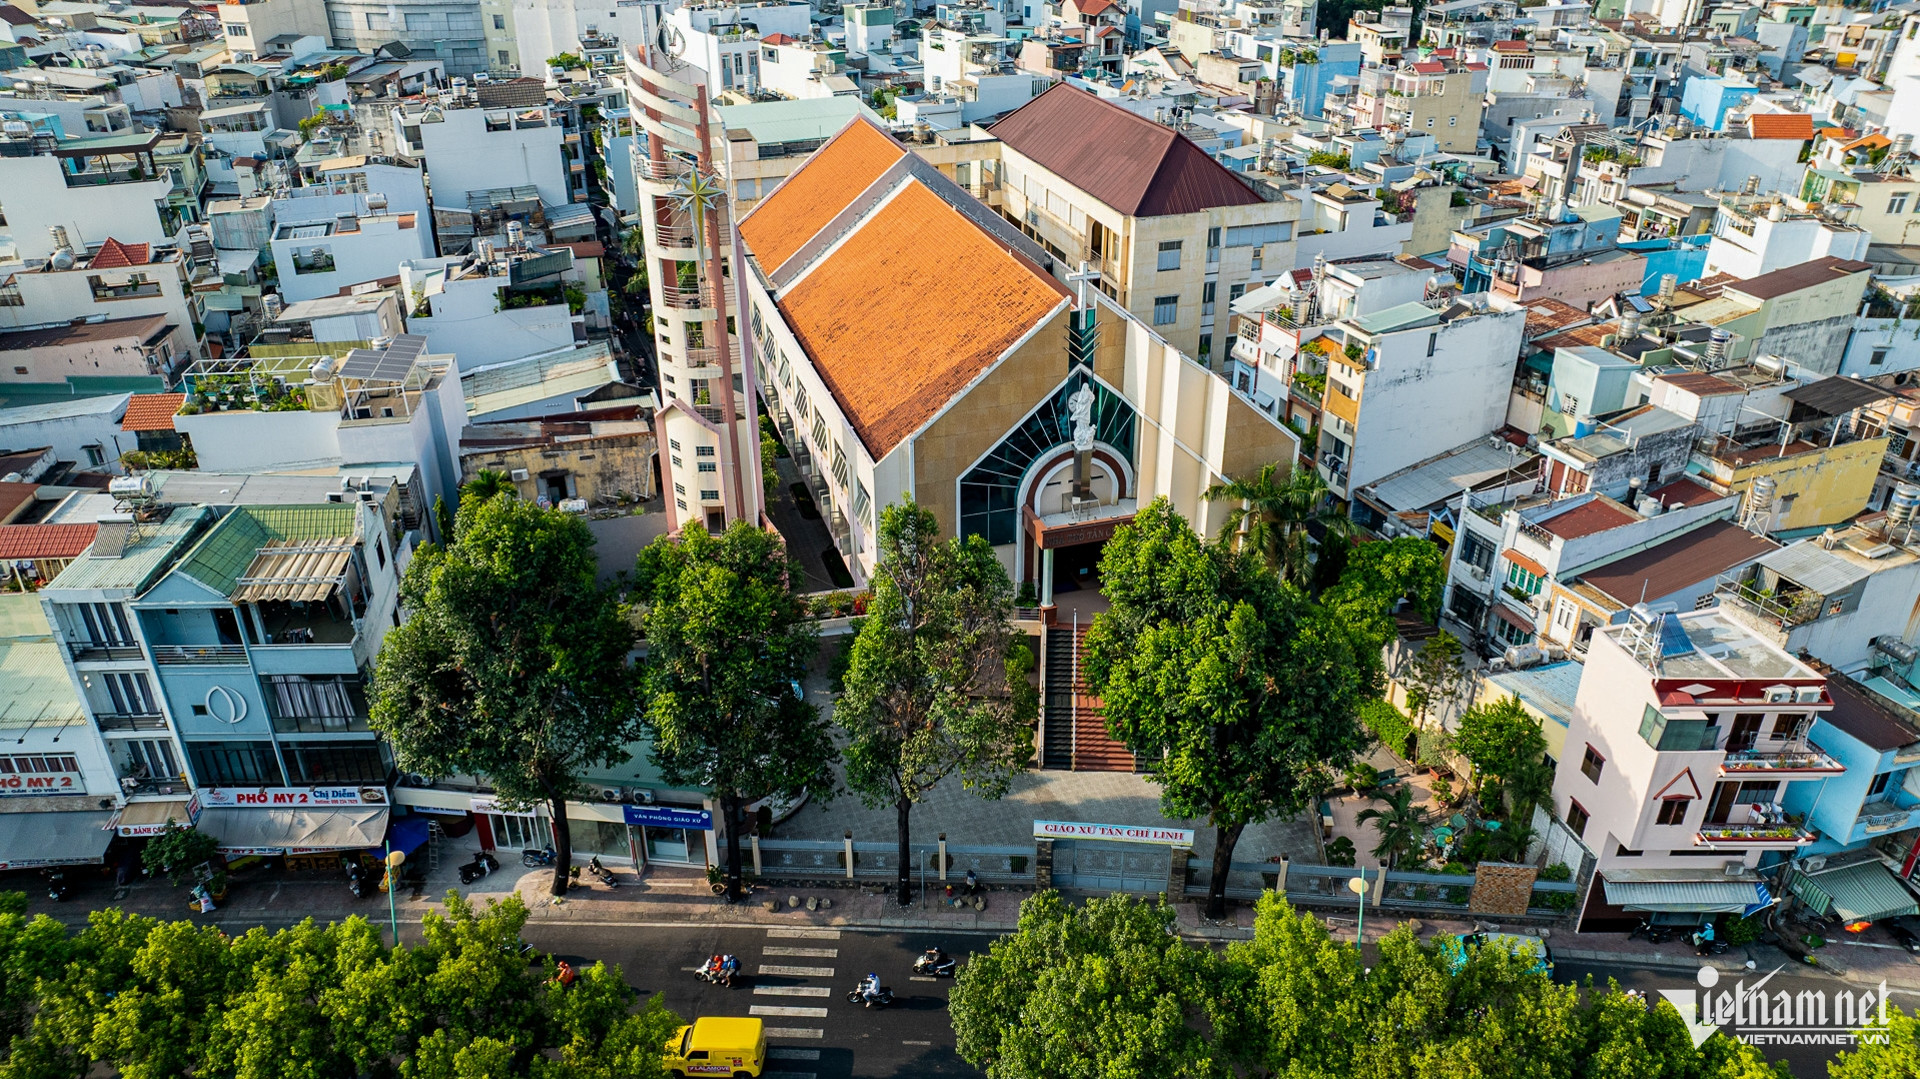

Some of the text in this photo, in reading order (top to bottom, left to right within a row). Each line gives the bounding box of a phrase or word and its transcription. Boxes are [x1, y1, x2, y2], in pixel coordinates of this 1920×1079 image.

[27, 777, 55, 788] MY
[60, 777, 72, 787] 2
[273, 793, 295, 804] MY
[298, 793, 308, 804] 2
[1044, 823, 1075, 833] GIÁO
[1099, 825, 1123, 836] TÂN
[1153, 831, 1185, 841] LINH
